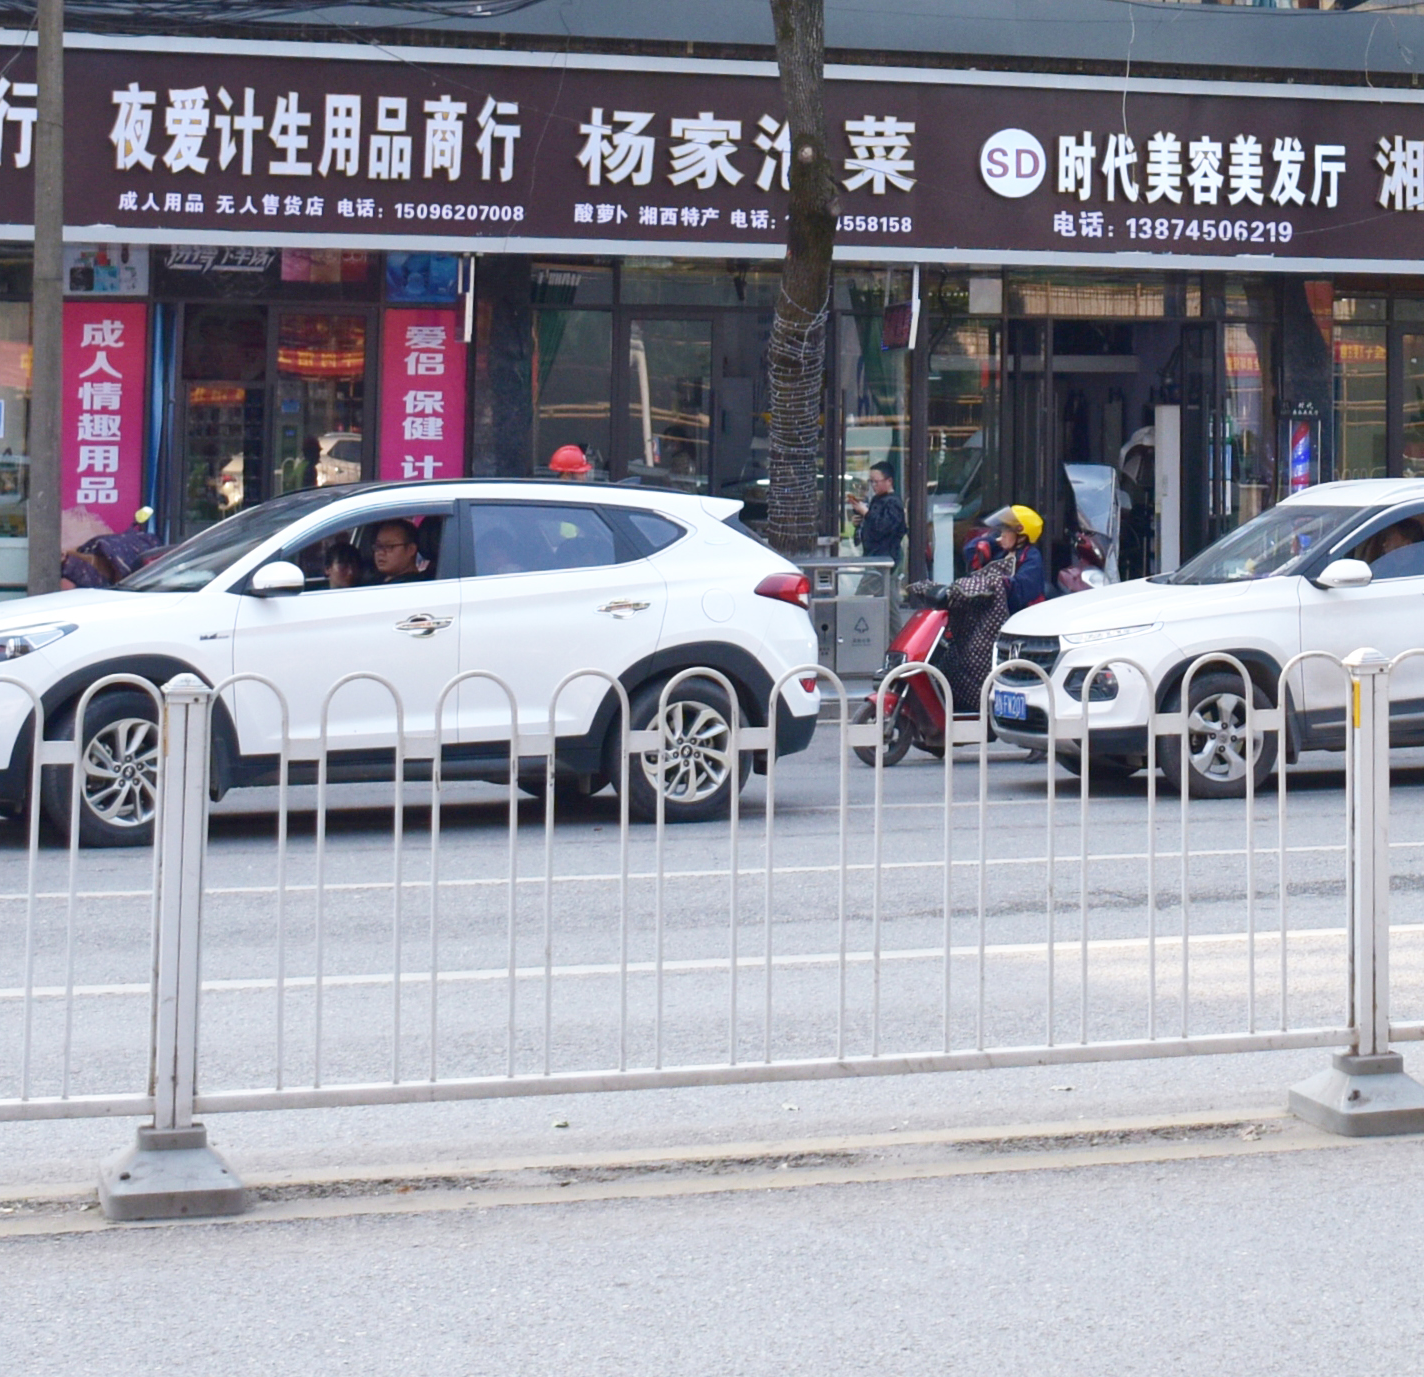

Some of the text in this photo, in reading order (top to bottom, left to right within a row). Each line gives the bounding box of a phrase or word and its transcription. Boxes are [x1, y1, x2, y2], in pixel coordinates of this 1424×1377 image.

[110, 83, 521, 182] 夜爱计生用品商行
[987, 148, 1039, 180] SD
[1057, 131, 1346, 209] 时代美容美发厅
[118, 191, 204, 213] 成人用品
[216, 194, 324, 217] 无人售货店
[574, 203, 628, 225] 酸萝卜
[639, 206, 720, 227] 湘西特产
[77, 321, 124, 505] 成人情趣用品
